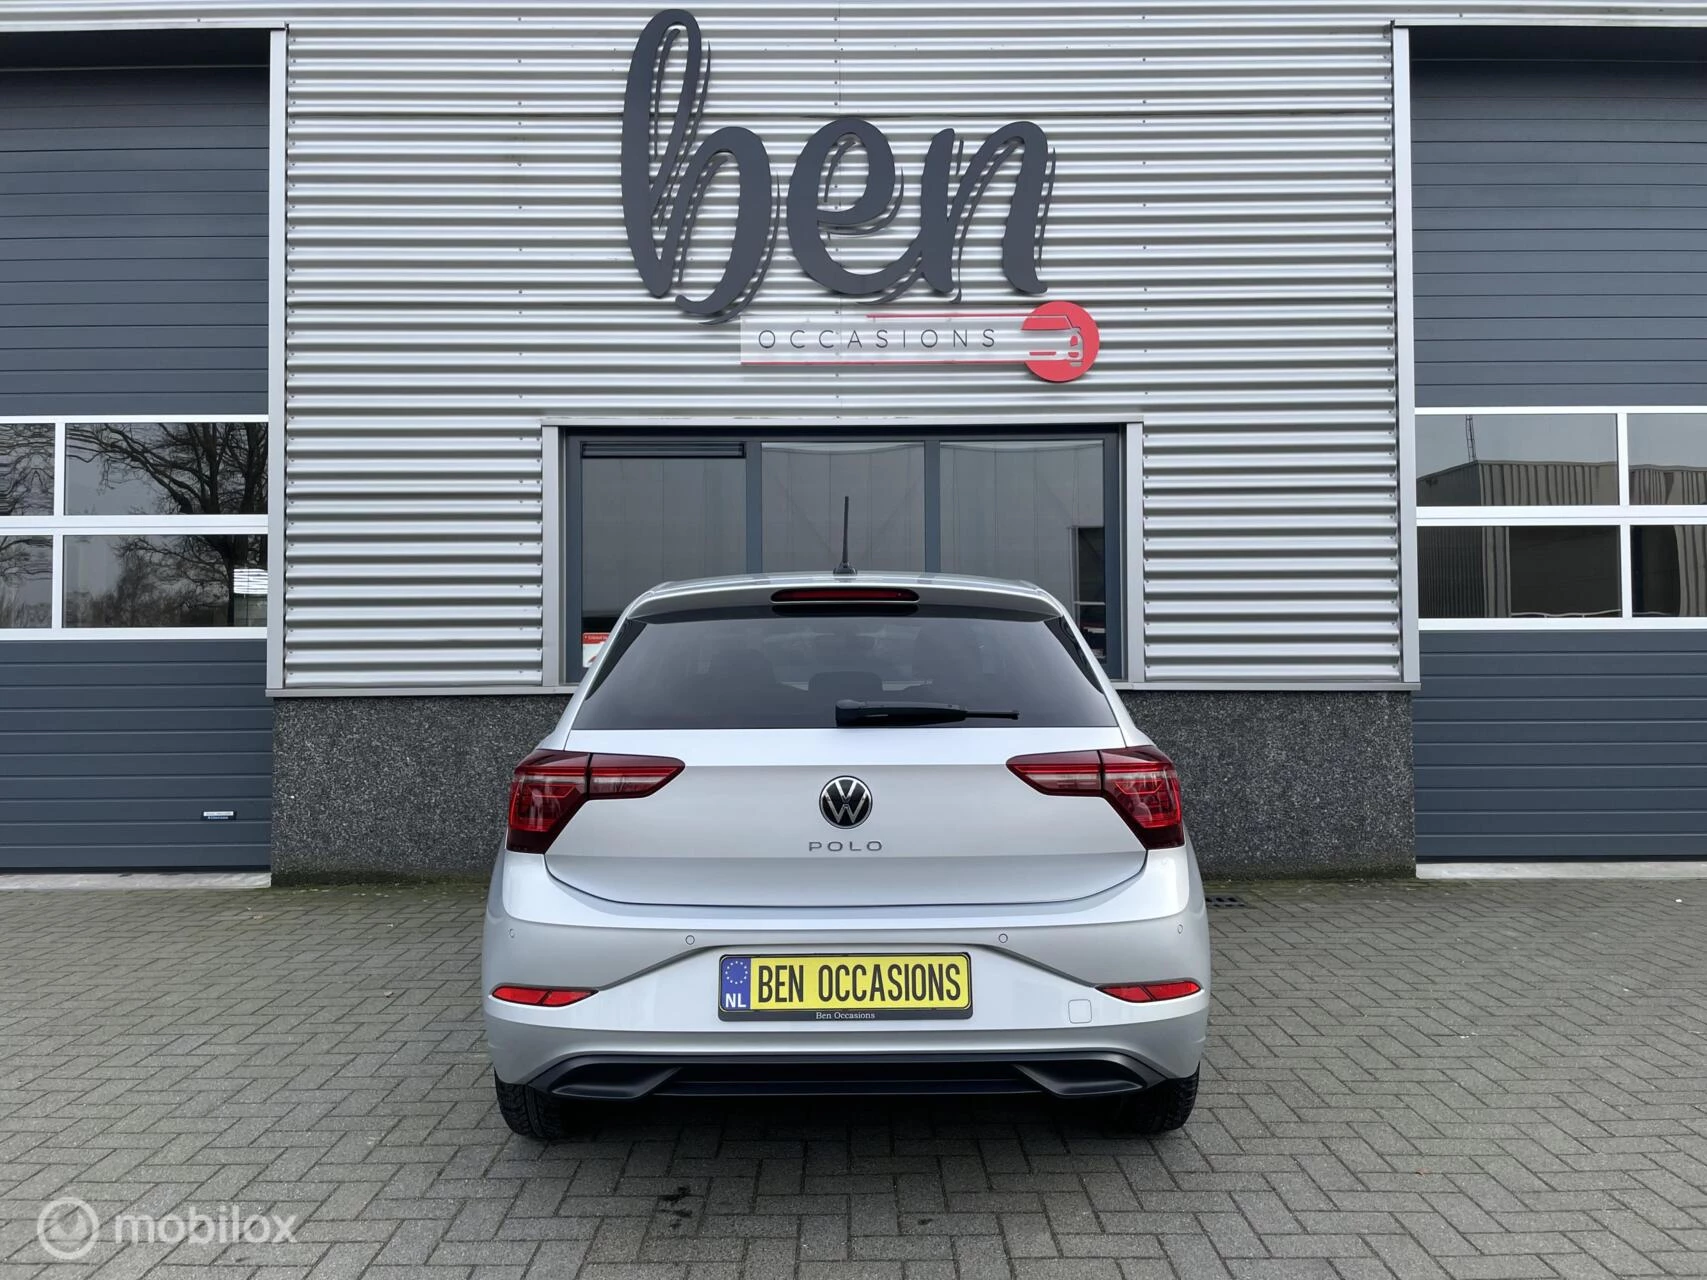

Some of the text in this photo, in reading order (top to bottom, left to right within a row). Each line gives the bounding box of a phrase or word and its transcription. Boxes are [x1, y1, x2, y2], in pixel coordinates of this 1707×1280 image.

[621, 9, 1048, 315] ben
[757, 328, 996, 349] OCCASIONS
[808, 840, 883, 852] POLO
[758, 963, 961, 1003] BEN OCCASIONS
[725, 993, 746, 1008] NL
[816, 1011, 876, 1020] Ben Occasions
